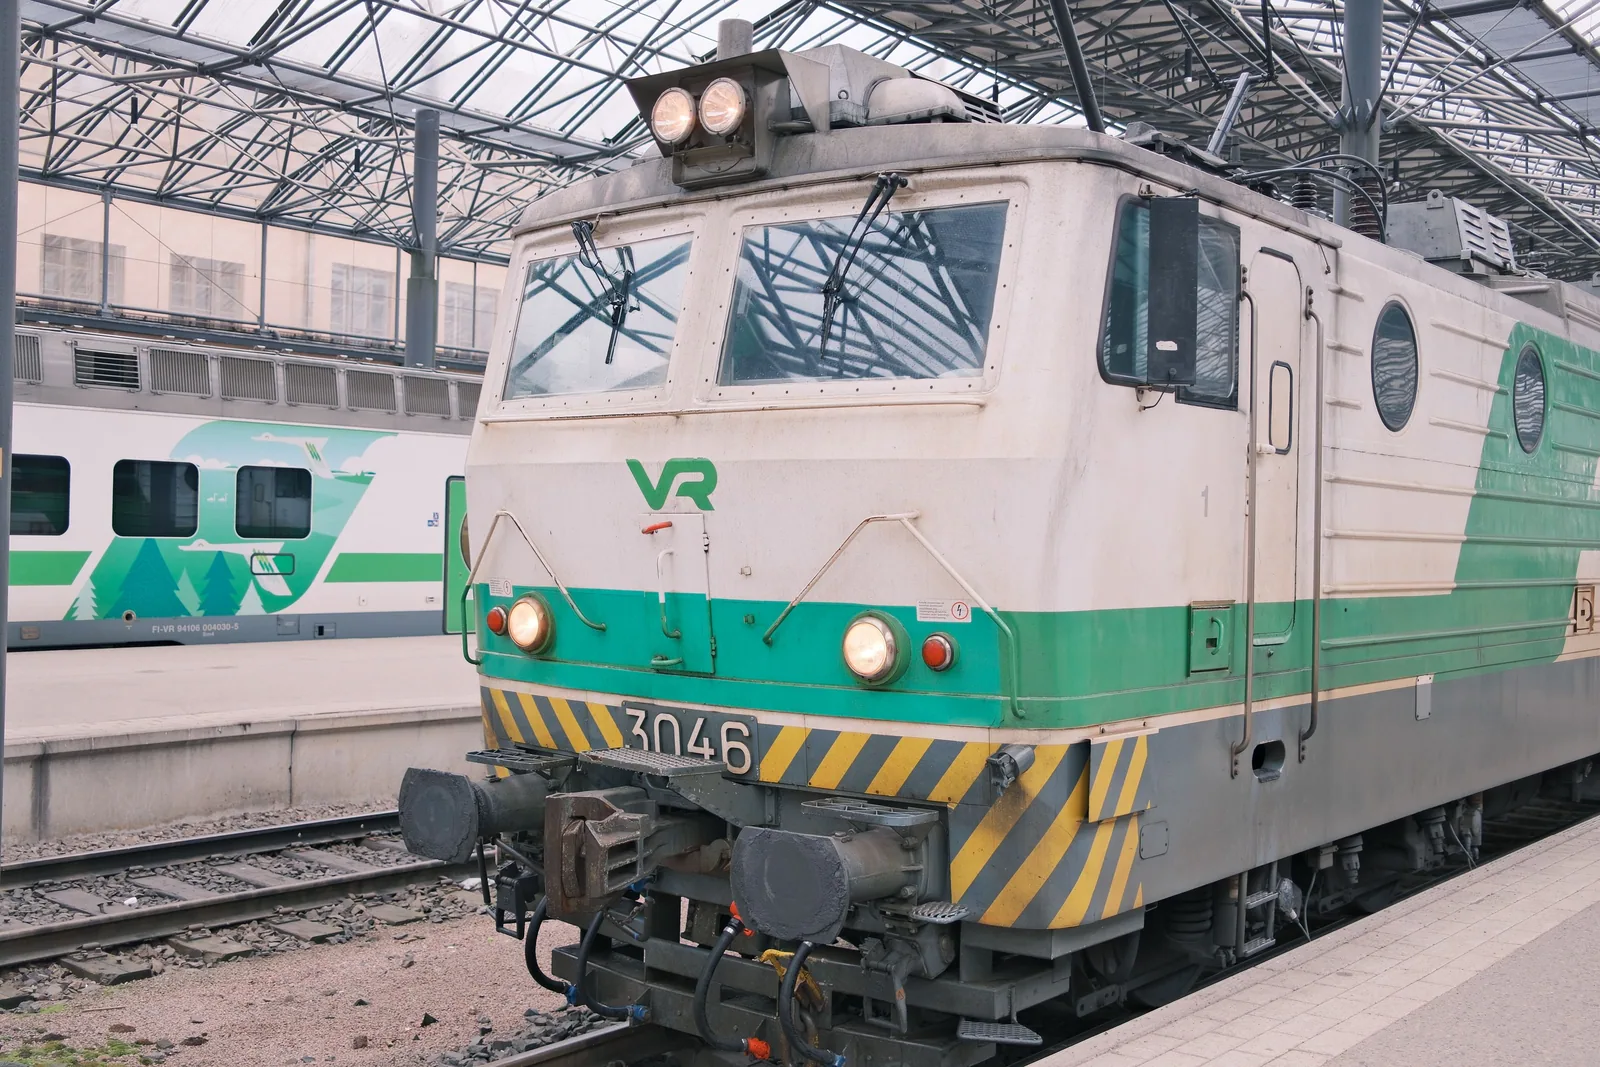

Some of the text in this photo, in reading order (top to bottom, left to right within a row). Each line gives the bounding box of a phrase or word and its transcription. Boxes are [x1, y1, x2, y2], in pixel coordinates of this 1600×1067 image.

[625, 457, 718, 511] VR
[1201, 485, 1209, 517] 1
[152, 622, 239, 633] FI-VR 94106 004030-5
[625, 708, 752, 775] 3046
